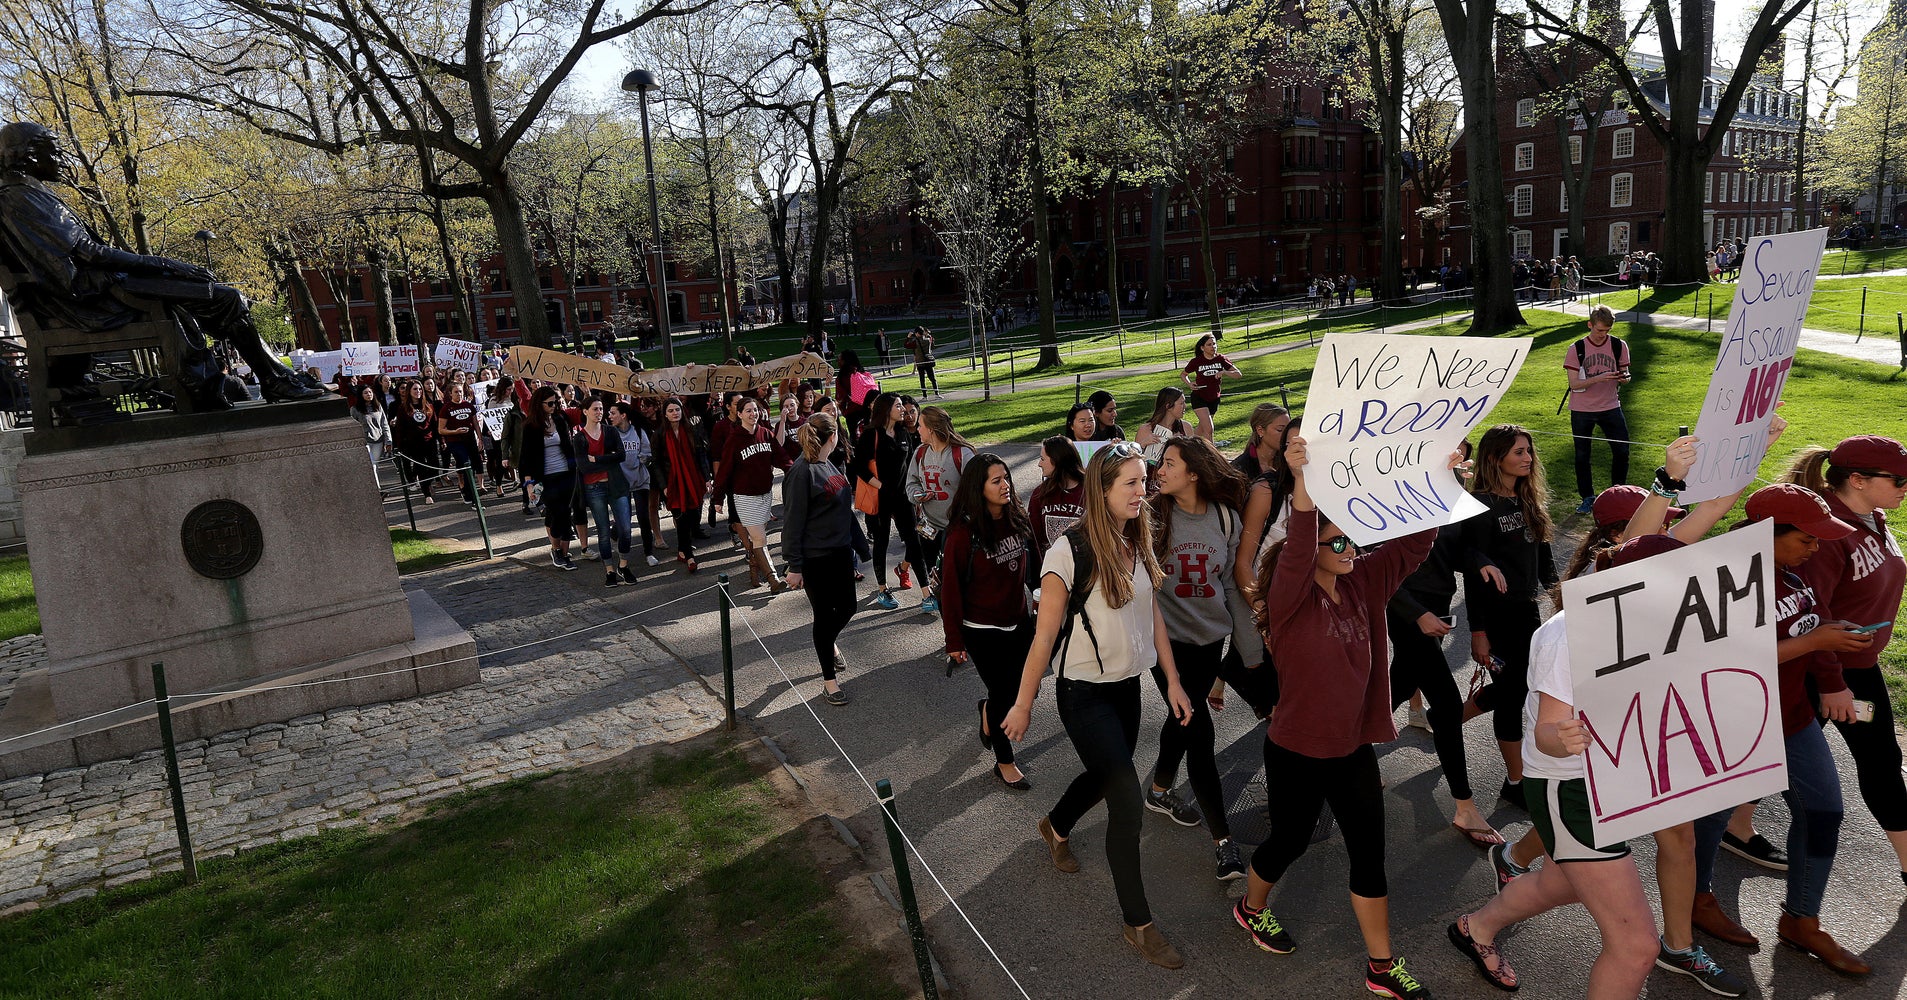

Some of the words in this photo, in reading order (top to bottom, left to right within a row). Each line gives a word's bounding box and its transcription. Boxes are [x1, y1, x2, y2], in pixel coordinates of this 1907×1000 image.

[1741, 235, 1825, 305] Sexual
[400, 346, 418, 357] Her
[454, 348, 477, 361] NOT
[1716, 299, 1807, 372] Assault
[380, 360, 419, 373] Harvard
[453, 361, 474, 370] FAULT
[516, 348, 617, 388] WOMEN'S
[627, 372, 697, 394] GROUPS
[705, 368, 743, 393] KEEP
[749, 362, 795, 389] WOMEN
[1198, 363, 1222, 371] HARVARD
[1332, 343, 1404, 390] We
[1417, 347, 1519, 390] Need
[1714, 387, 1734, 412] is
[1735, 356, 1793, 426] NOT
[450, 408, 472, 416] HARVARD
[1319, 408, 1344, 436] a
[1348, 394, 1490, 442] ROOM
[1330, 447, 1361, 489] of
[1375, 440, 1434, 475] our
[1041, 503, 1083, 515] DUNSTE
[1347, 471, 1450, 531] OWN
[1170, 542, 1206, 555] PROPERTY
[1208, 546, 1217, 554] OF
[1178, 554, 1208, 584] H
[1191, 585, 1205, 597] 16
[1586, 581, 1650, 678] I
[1663, 552, 1766, 655] AM
[1579, 668, 1769, 817] MAD
